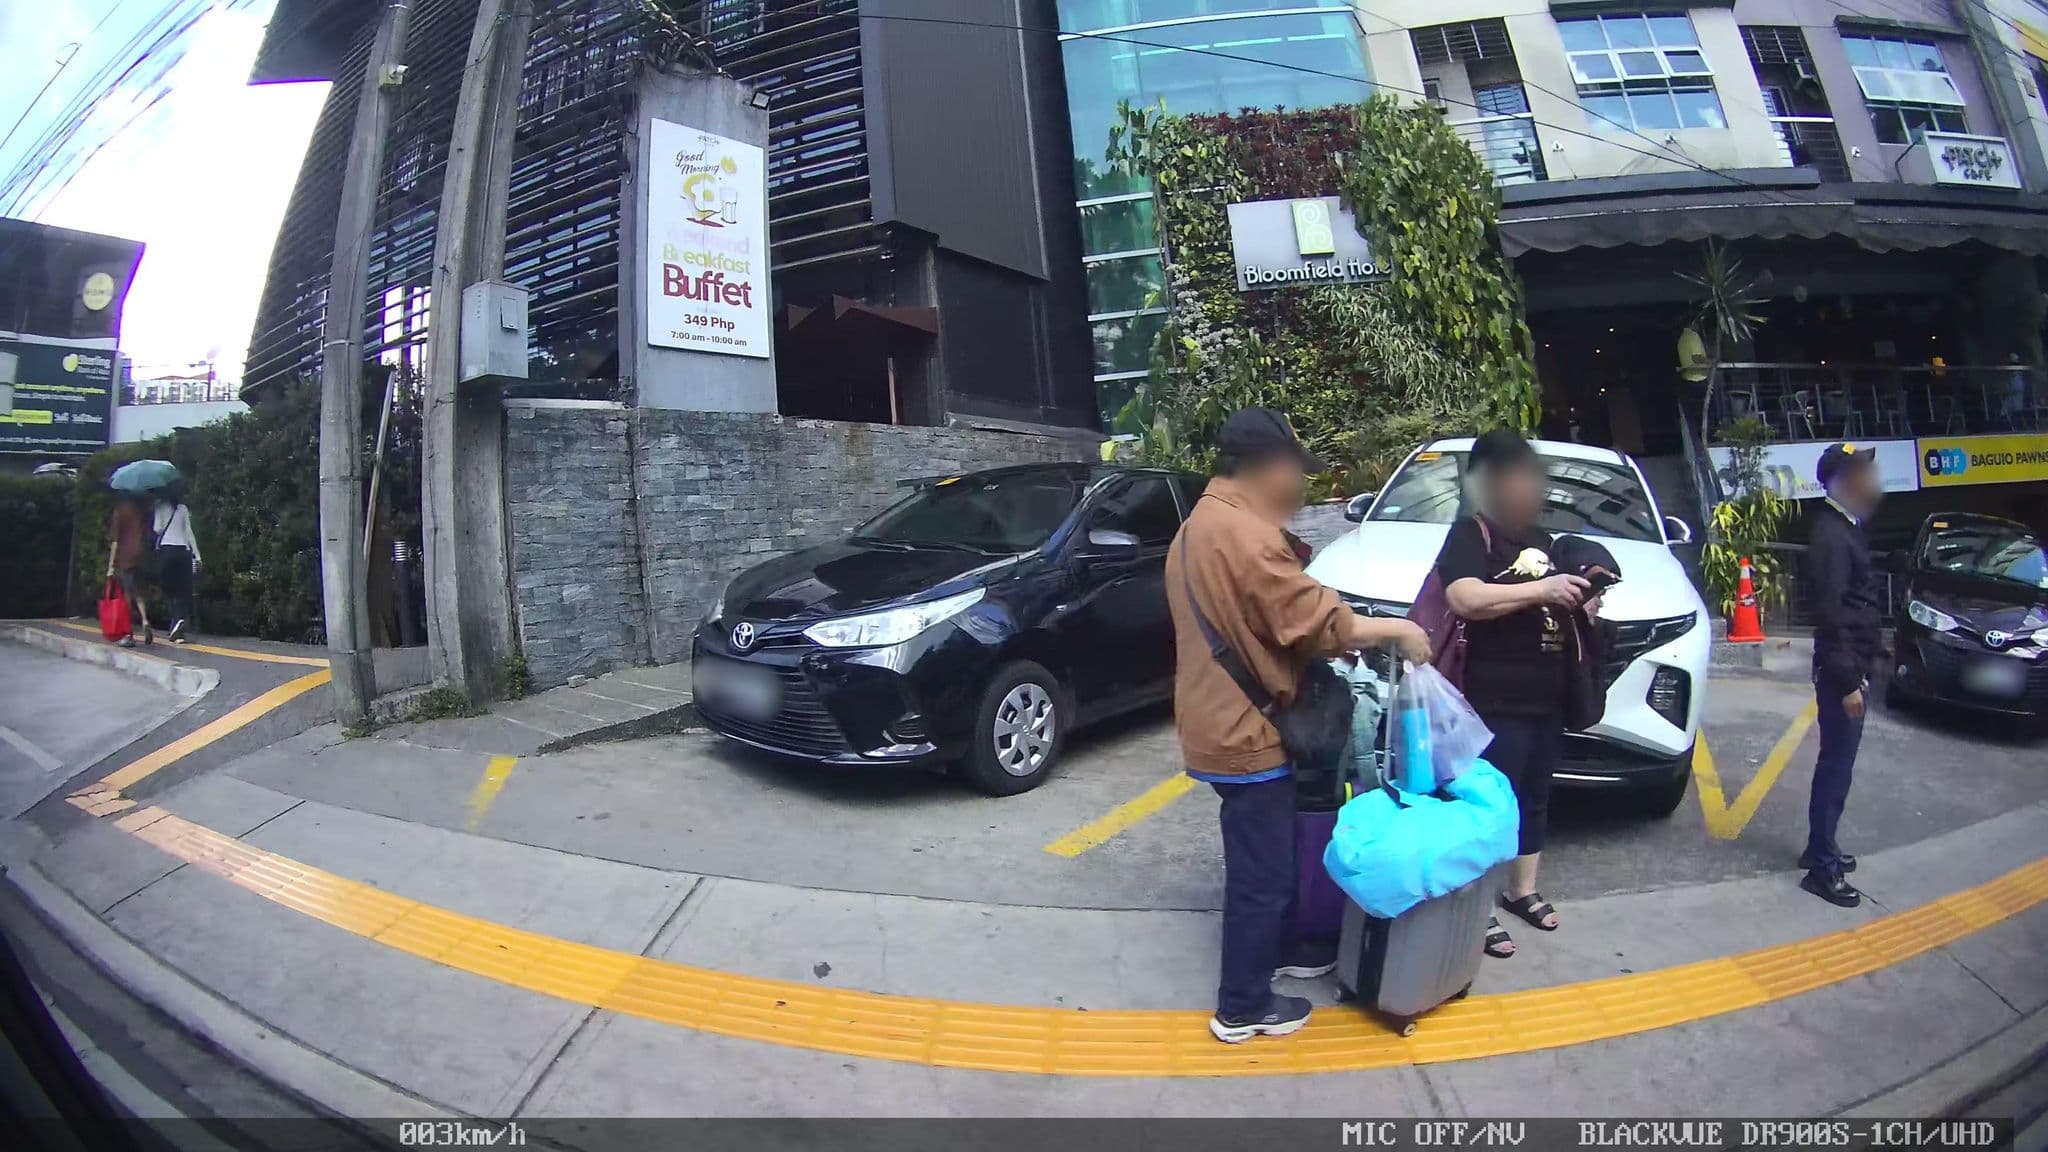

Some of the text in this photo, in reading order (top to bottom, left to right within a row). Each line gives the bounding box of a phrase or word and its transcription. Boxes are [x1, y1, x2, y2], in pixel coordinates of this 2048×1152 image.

[675, 149, 704, 167] Good
[680, 163, 720, 175] Morning
[1245, 259, 1344, 285] Bloomfield
[663, 263, 752, 309] Buffet
[684, 314, 735, 332] 349 Php
[670, 331, 690, 340] 7:00
[692, 333, 705, 342] am
[711, 335, 733, 345] 10:00
[735, 338, 747, 346] am
[1971, 453, 2013, 467] BAGUIO
